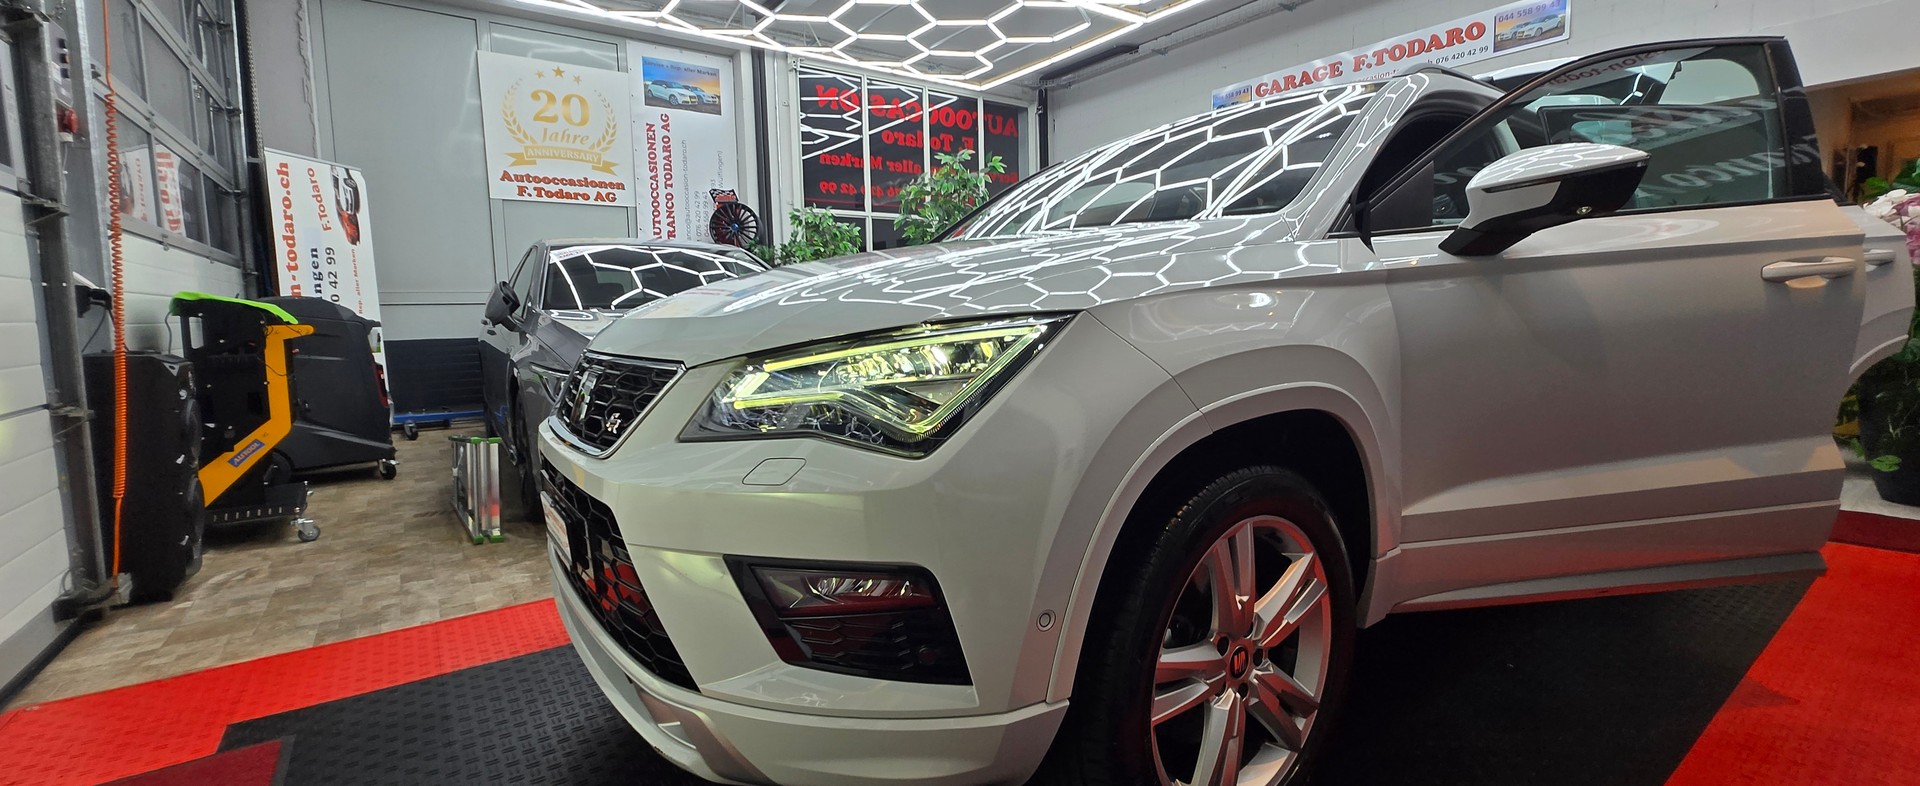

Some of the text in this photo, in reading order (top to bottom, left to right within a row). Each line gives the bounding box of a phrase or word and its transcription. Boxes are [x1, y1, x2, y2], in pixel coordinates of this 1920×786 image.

[1498, 12, 1514, 22] 044
[1517, 8, 1533, 18] 558
[1536, 4, 1547, 12] 99
[1255, 21, 1487, 97] GARAGE F.TODARO
[1435, 55, 1449, 64] 076
[1451, 51, 1466, 60] 420
[1467, 48, 1477, 56] 42
[1479, 45, 1489, 53] 99
[530, 89, 590, 127] 20
[660, 113, 670, 133] AG
[541, 127, 590, 145] Jahre
[527, 148, 600, 164] ANNIVERSARY
[661, 135, 673, 189] TODARO
[500, 170, 626, 191] Autooccasionen
[307, 167, 332, 231] F.Todaro
[516, 185, 617, 203] F. Todaro AG
[693, 190, 700, 200] 99
[325, 247, 337, 265] 99
[351, 248, 359, 277] Marken
[310, 247, 324, 298] ngen
[327, 271, 340, 289] 42
